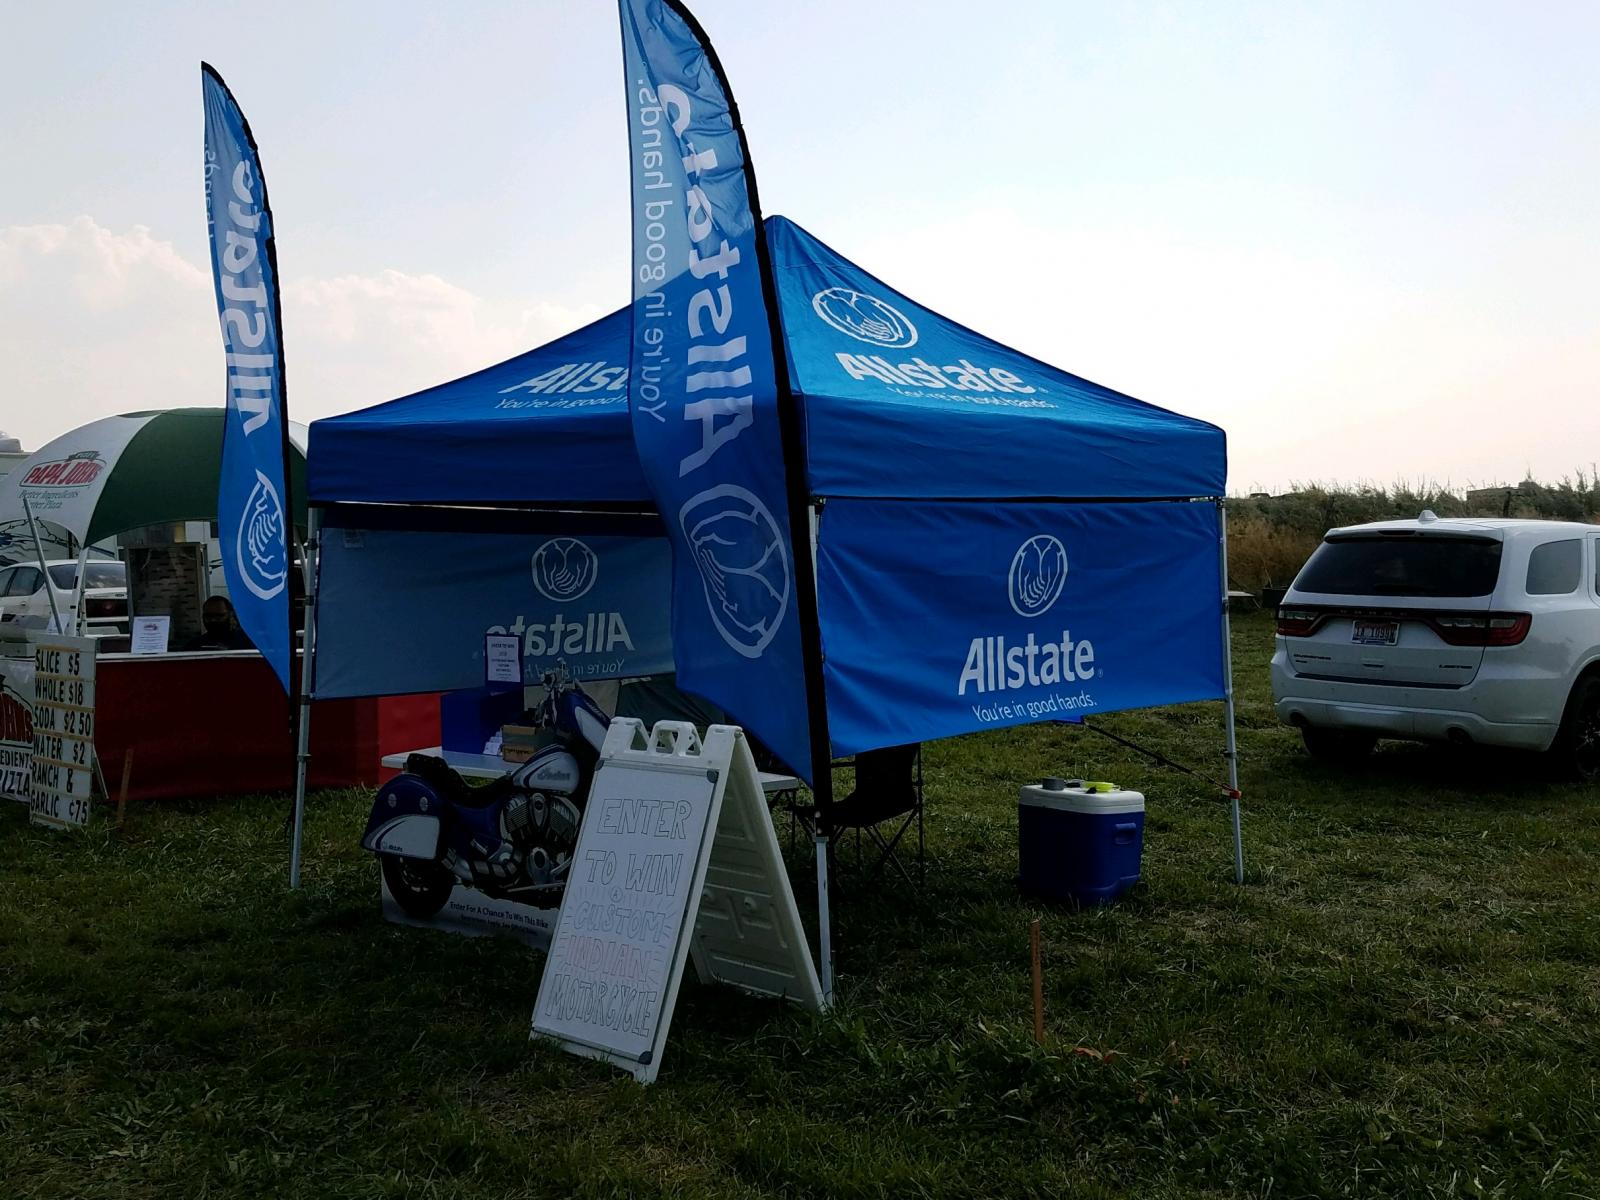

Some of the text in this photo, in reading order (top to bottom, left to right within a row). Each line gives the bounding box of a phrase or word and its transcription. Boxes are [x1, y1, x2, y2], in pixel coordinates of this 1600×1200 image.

[497, 361, 629, 394] Allst
[835, 352, 1037, 394] Allstate
[23, 462, 72, 485] PAPA
[35, 649, 80, 676] SLICE $5
[958, 630, 1095, 696] Allstate
[35, 677, 84, 706] WHOLE $18
[972, 690, 1098, 723] You're in good hands.
[33, 706, 56, 731] SODA
[32, 733, 86, 765] WATER $2
[31, 761, 74, 794] RANCH &
[30, 789, 60, 818] GARLIC
[596, 798, 692, 840] ENTER
[585, 850, 684, 897] TO WIN
[449, 901, 465, 911] Enter
[482, 907, 505, 918] Chance
[536, 918, 549, 929] Bike
[573, 900, 666, 943] CUSTOM
[566, 934, 652, 983] INDIAN
[545, 973, 658, 1038] MOTORCYCLE
